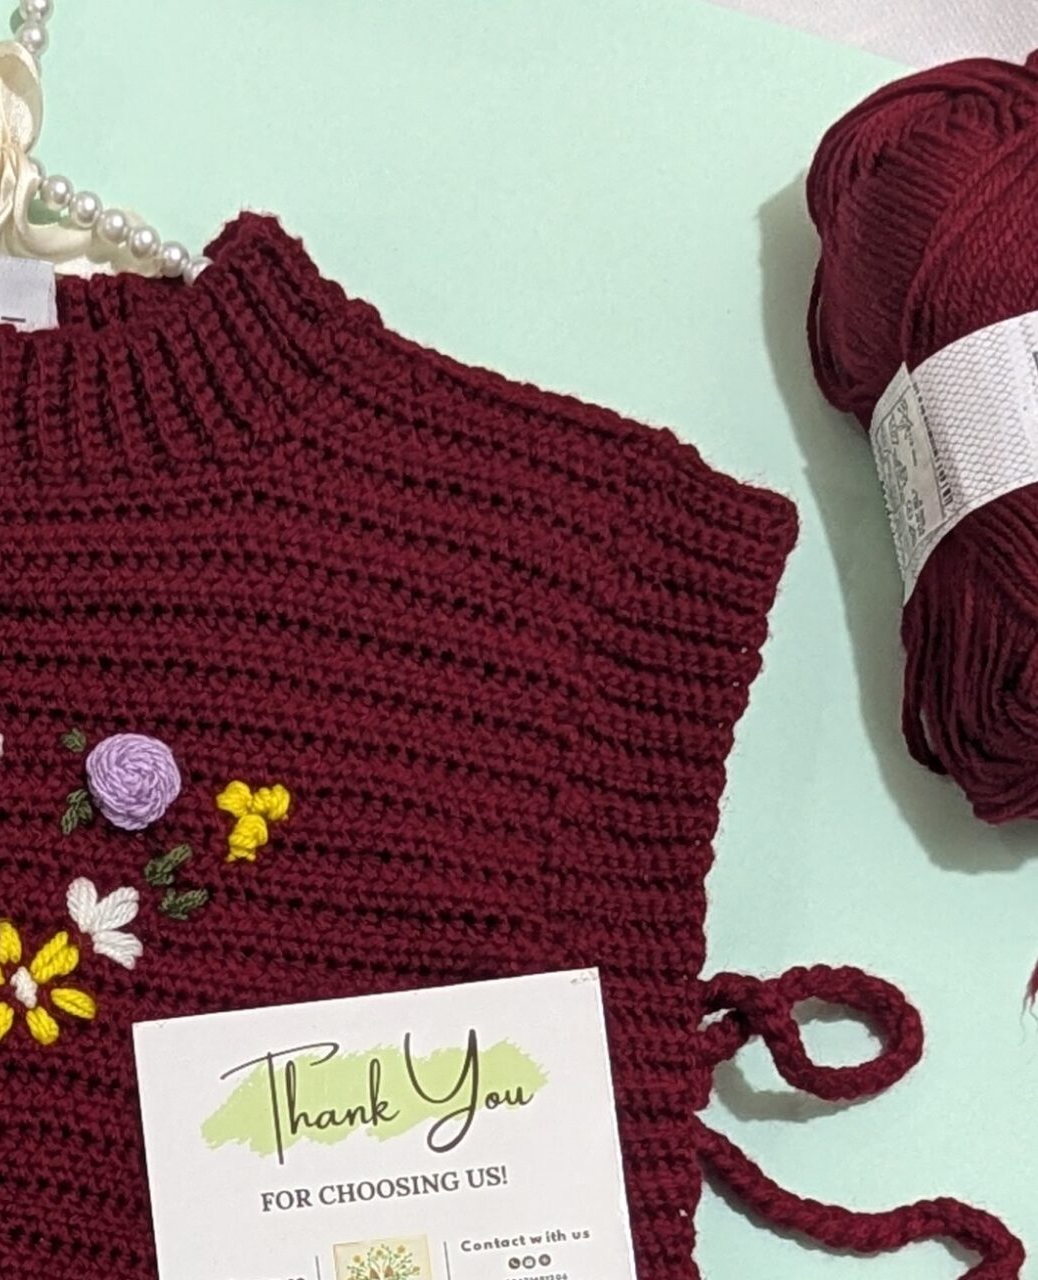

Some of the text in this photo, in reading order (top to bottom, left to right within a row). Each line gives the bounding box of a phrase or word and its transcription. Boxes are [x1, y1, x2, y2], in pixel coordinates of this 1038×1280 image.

[220, 1028, 535, 1165] Thank You
[261, 1165, 509, 1212] FOR CHOOSING US!
[460, 1228, 591, 1252] Contact with us
